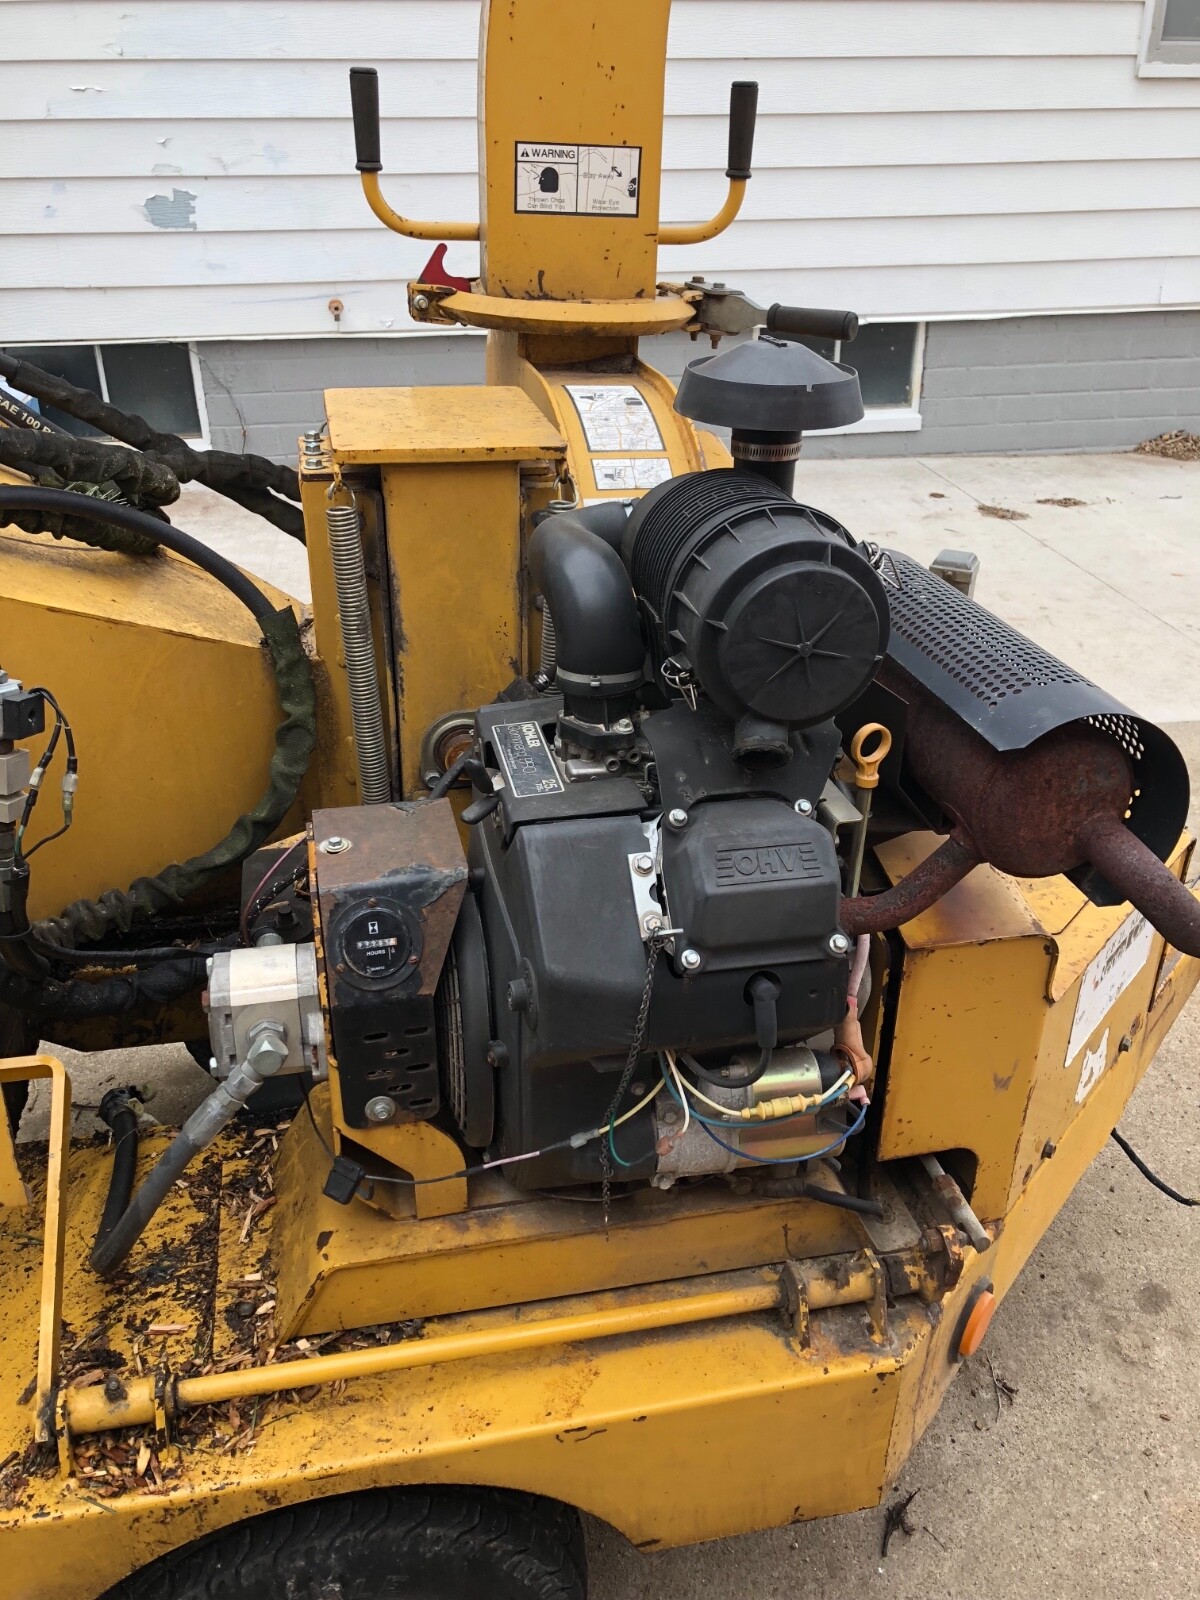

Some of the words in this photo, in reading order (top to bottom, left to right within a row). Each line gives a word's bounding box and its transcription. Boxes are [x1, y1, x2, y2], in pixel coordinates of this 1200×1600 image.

[531, 148, 575, 159] WARNING
[583, 172, 596, 180] Stay
[21, 412, 41, 430] 100
[520, 724, 541, 748] KOHLER
[542, 778, 558, 789] 25
[733, 848, 799, 876] OHV
